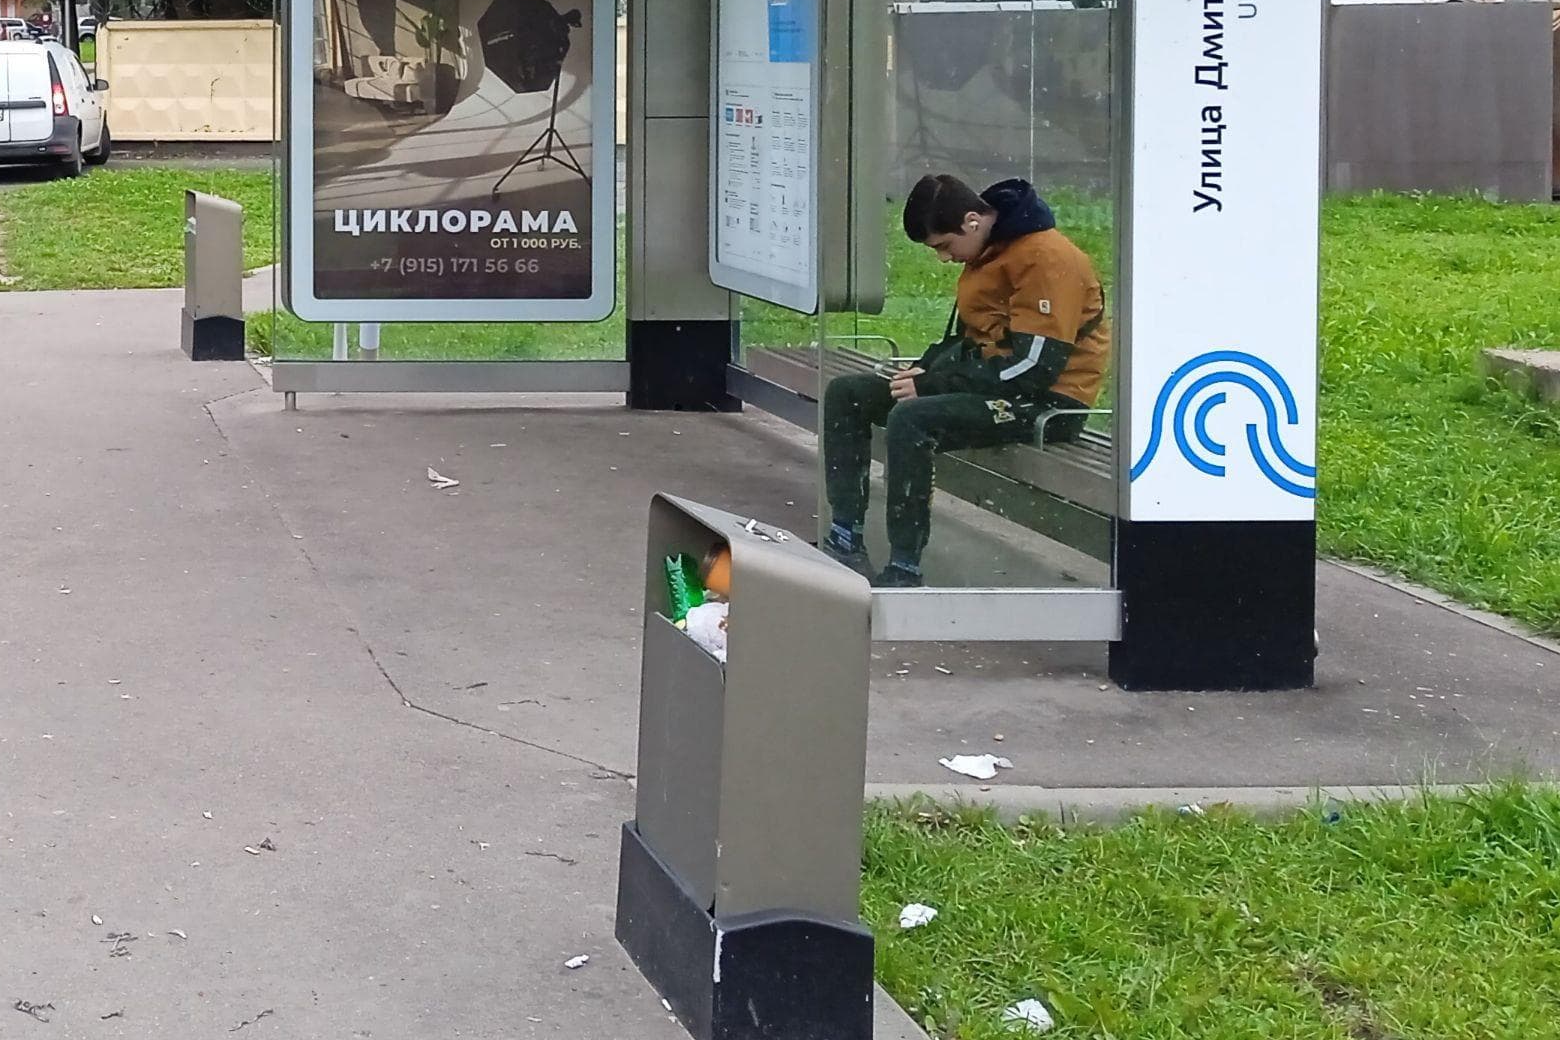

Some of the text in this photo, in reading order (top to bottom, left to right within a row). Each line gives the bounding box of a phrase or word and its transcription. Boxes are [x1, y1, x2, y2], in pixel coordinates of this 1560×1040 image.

[1192, 103, 1226, 214] Улица
[334, 209, 578, 236] ЦИКЛОРАМА
[490, 238, 582, 249] ОТ 1 000 РУБ.
[370, 257, 539, 276] +7 (915) 171 56 66
